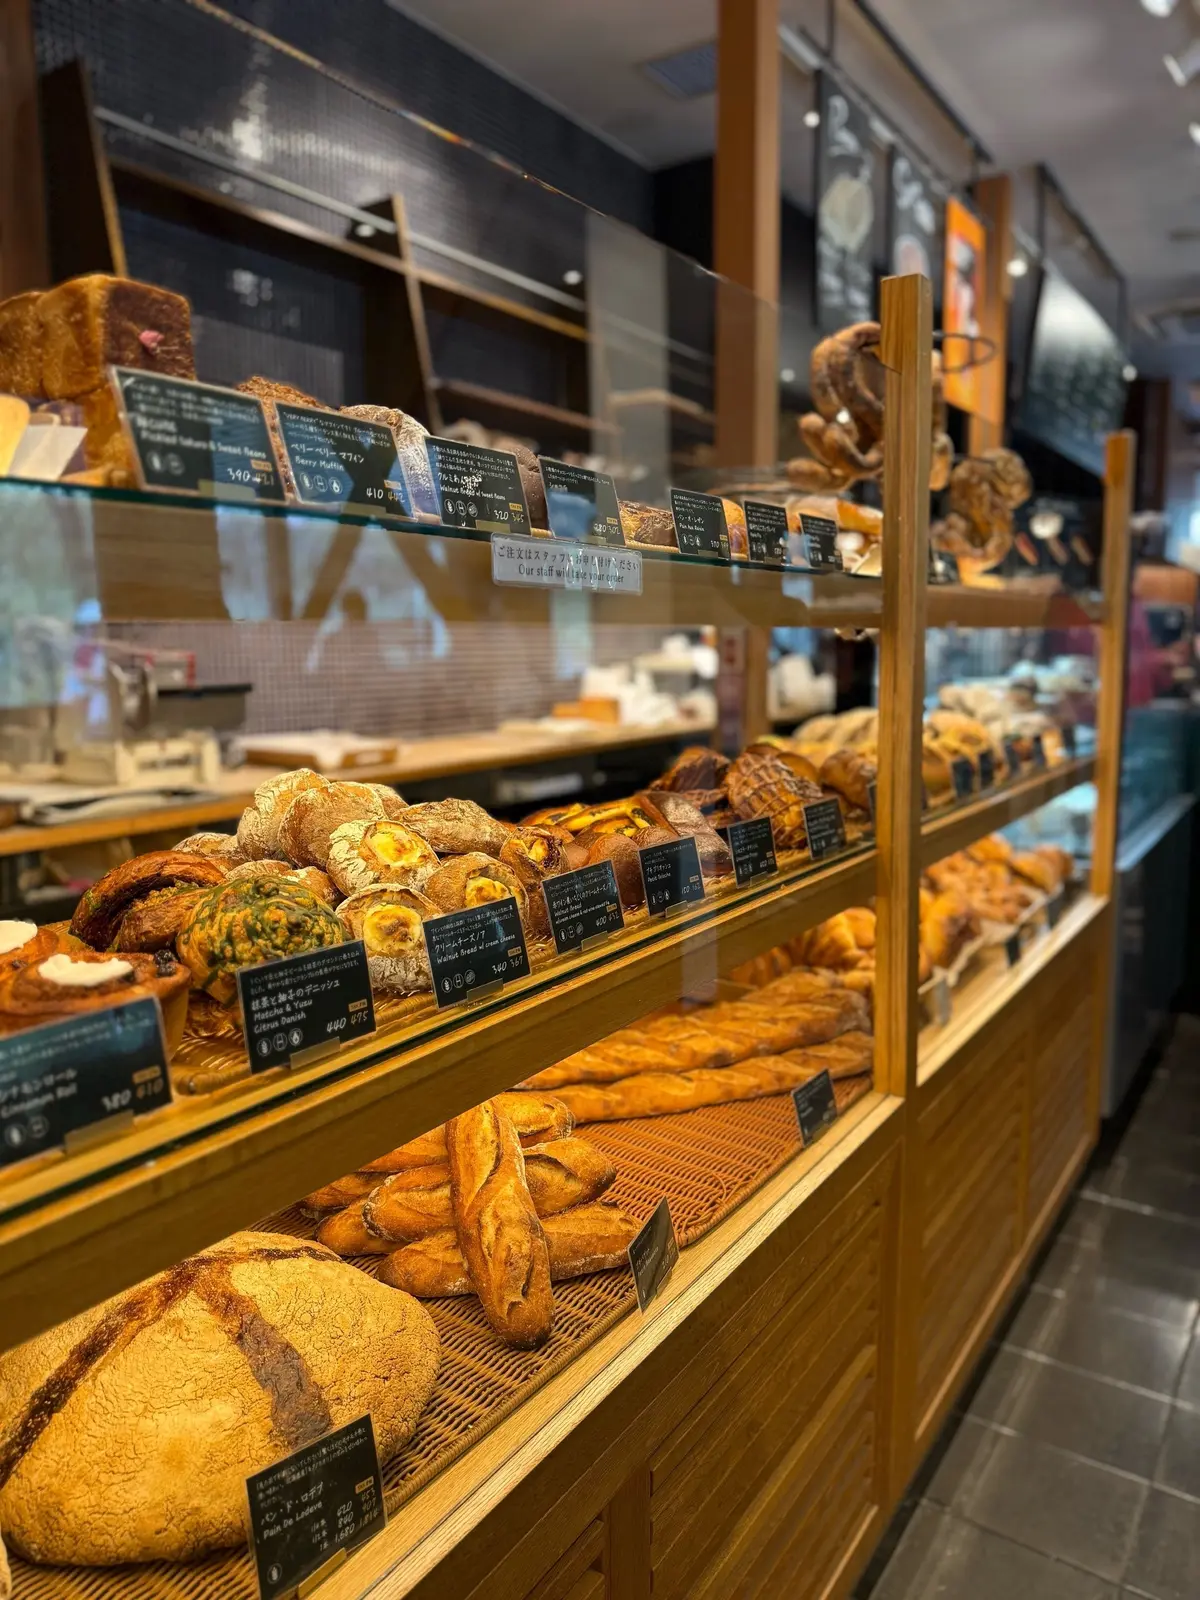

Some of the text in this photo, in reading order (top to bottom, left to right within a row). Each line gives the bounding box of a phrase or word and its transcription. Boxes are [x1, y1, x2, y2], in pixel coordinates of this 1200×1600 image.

[295, 455, 345, 472] Berry Muffin
[227, 467, 250, 482] 390
[366, 487, 406, 503] 410 442
[494, 509, 509, 520] 320
[518, 564, 624, 583] Our staff will take your order
[436, 952, 459, 964] Walnut
[460, 946, 478, 957] Bread
[485, 939, 499, 948] cream
[500, 934, 516, 943] cheese
[491, 955, 524, 974] 340 367
[251, 979, 341, 1011] 抹茶と柚子のデニッシュ
[254, 998, 313, 1022] Matcha & Yuzu
[254, 1010, 307, 1034] Citrus Danish
[326, 1010, 369, 1033] 440 475
[336, 1500, 353, 1517] 420
[263, 1501, 323, 1540] Pain De Lodeve
[337, 1511, 354, 1529] 840
